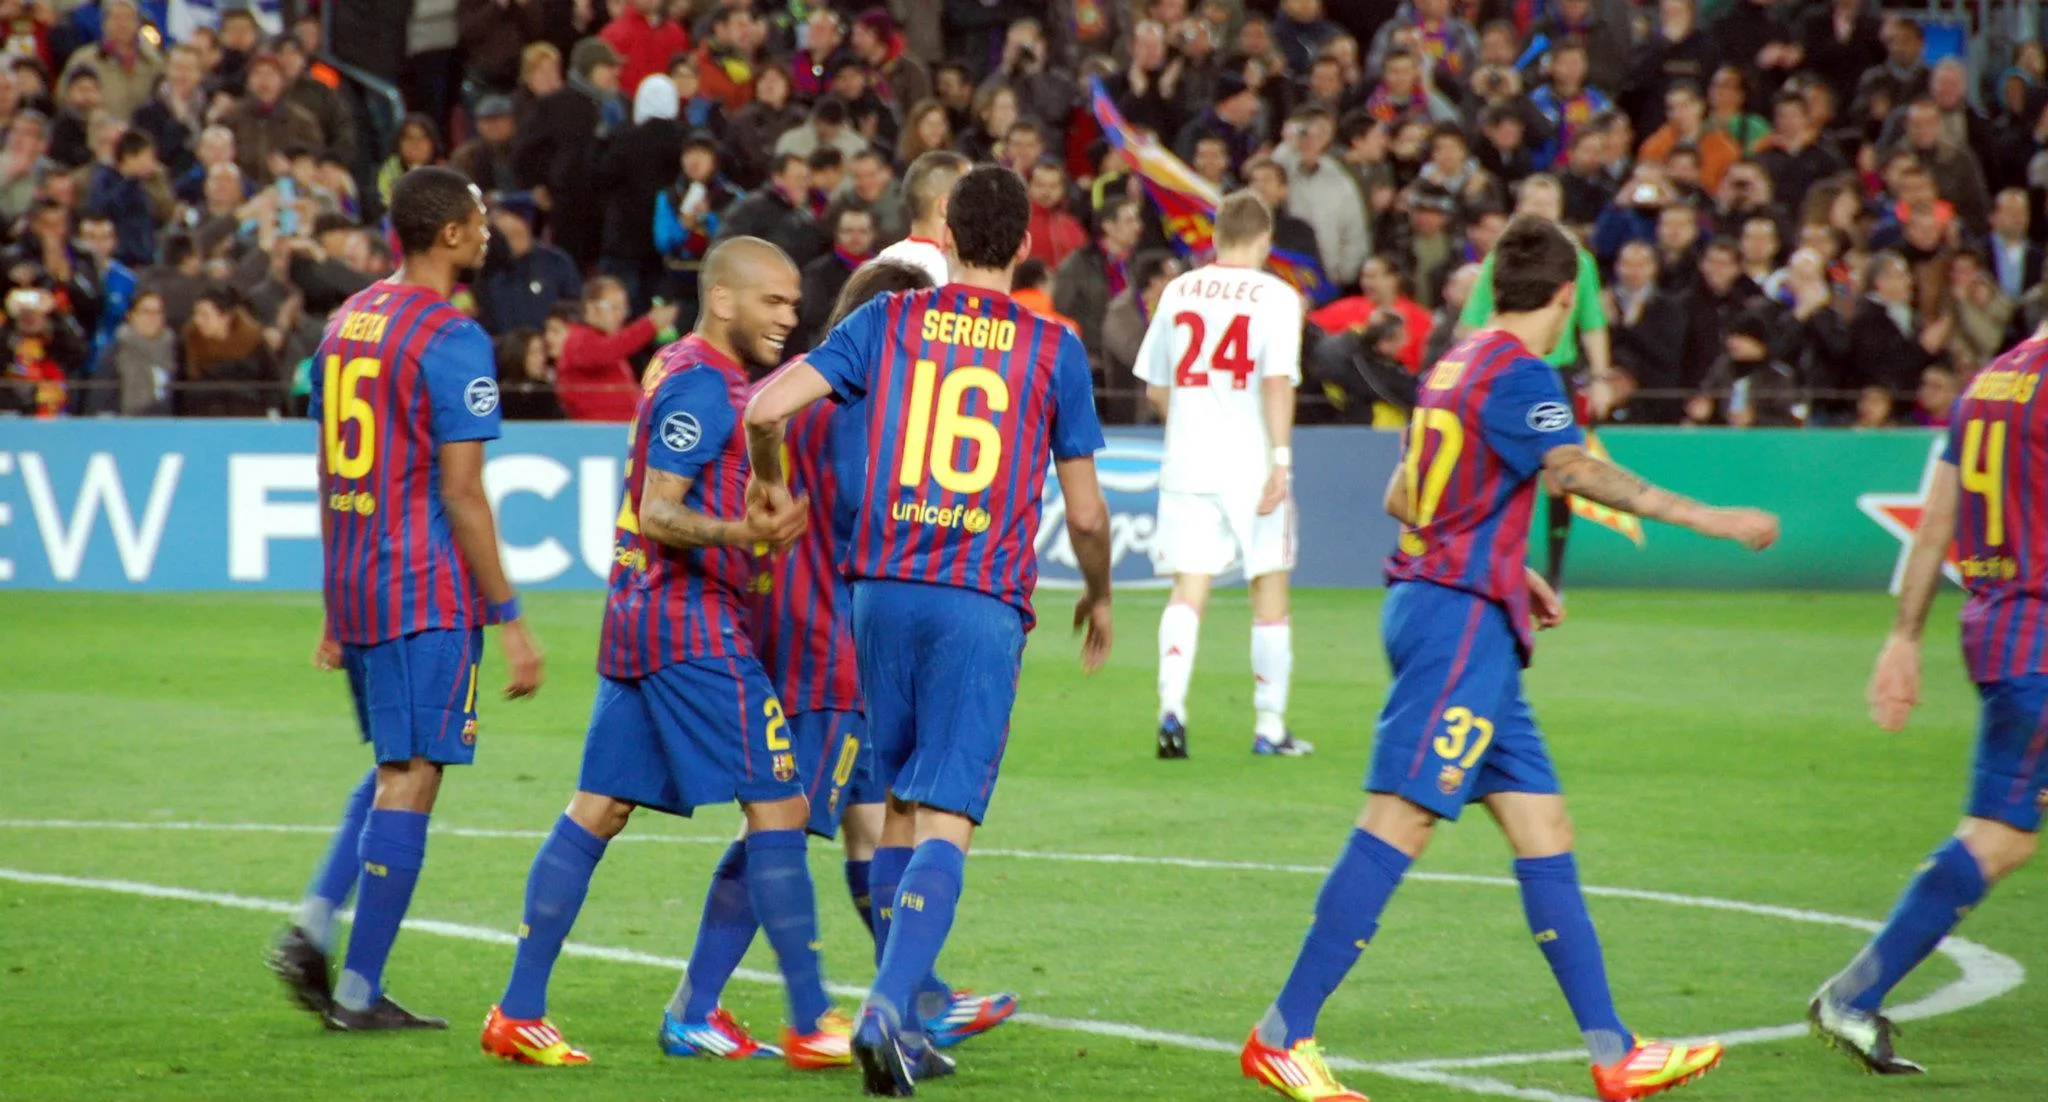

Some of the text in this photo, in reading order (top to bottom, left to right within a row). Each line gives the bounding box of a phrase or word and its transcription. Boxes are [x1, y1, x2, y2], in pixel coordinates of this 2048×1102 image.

[921, 309, 1016, 352] SERGIO
[1174, 310, 1255, 390] 24
[898, 358, 1010, 494] 16
[0, 450, 185, 582] W
[891, 500, 964, 529] unicef
[1960, 417, 2006, 547] 4
[763, 696, 790, 752] 2
[1433, 706, 1494, 770] 37
